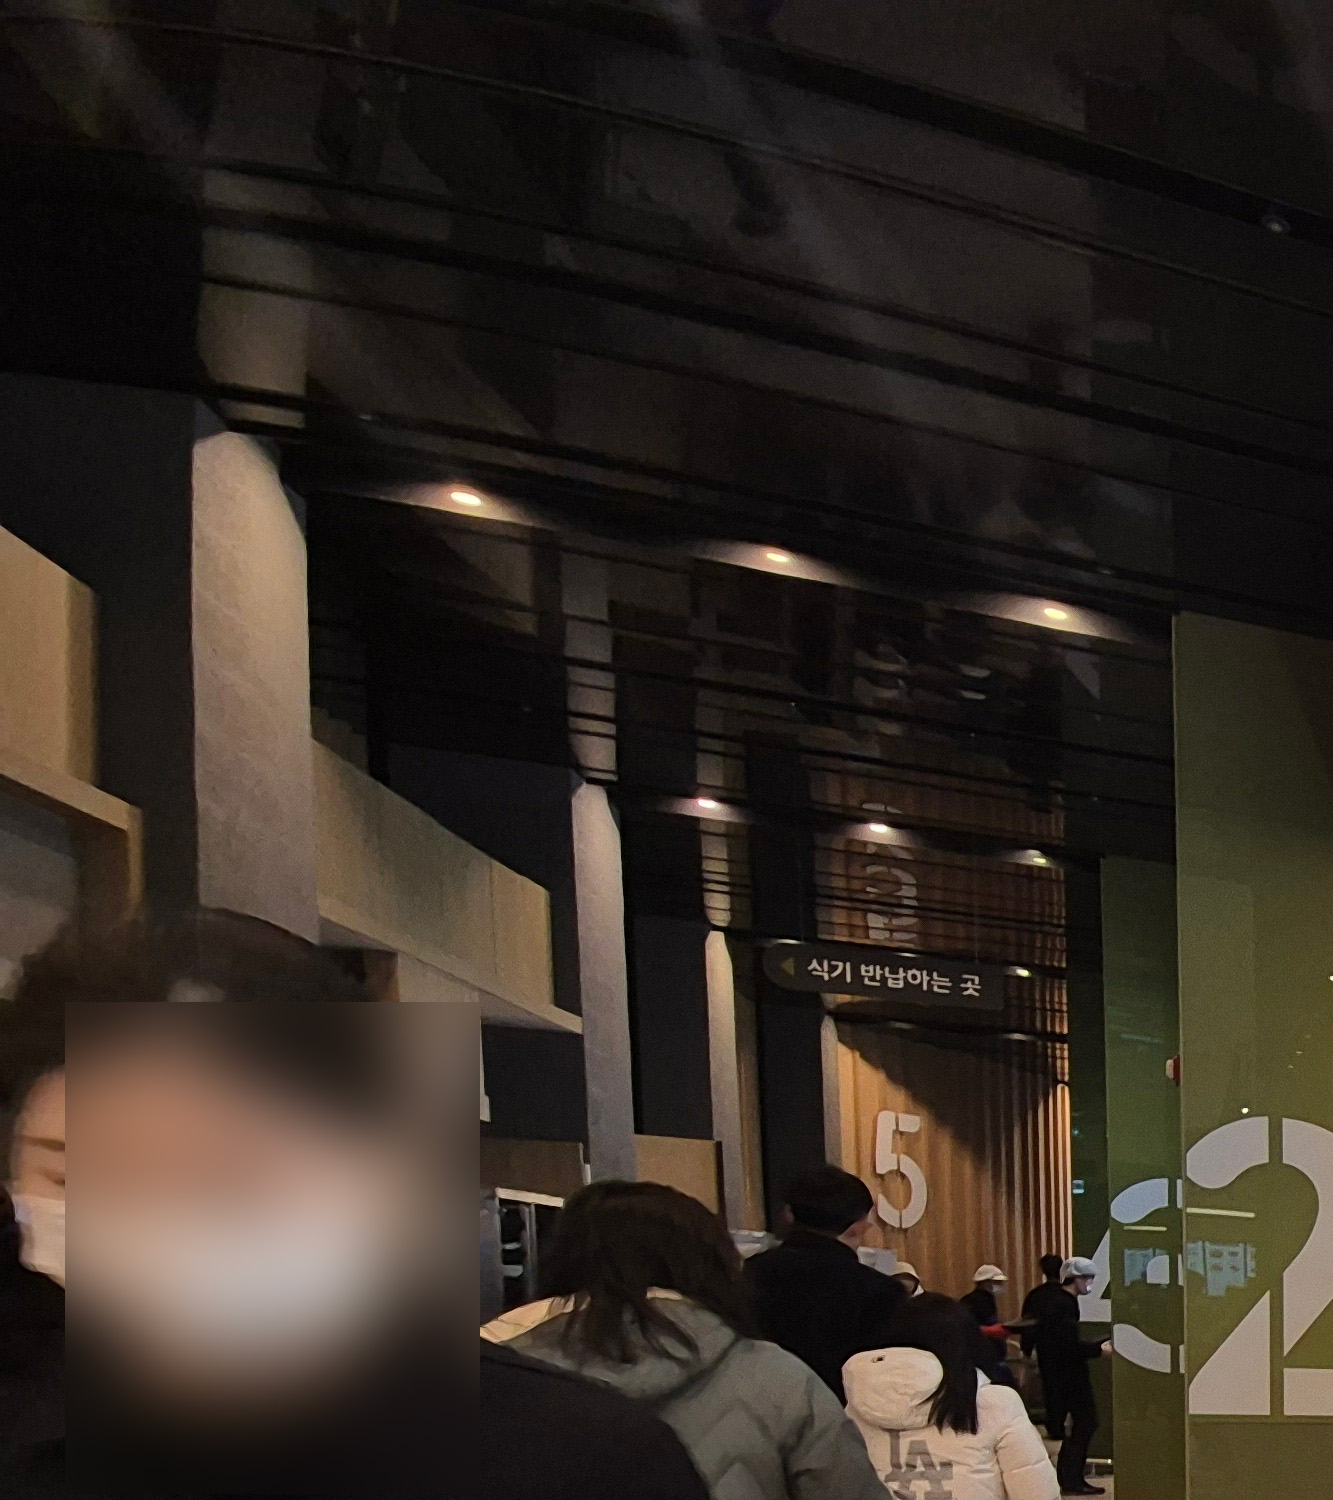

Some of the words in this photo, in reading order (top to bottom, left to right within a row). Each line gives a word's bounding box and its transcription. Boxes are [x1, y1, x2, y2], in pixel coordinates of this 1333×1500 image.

[807, 957, 851, 985] 식기
[860, 963, 953, 995] 반납하는
[959, 973, 982, 998] 곳
[876, 1109, 928, 1229] 5
